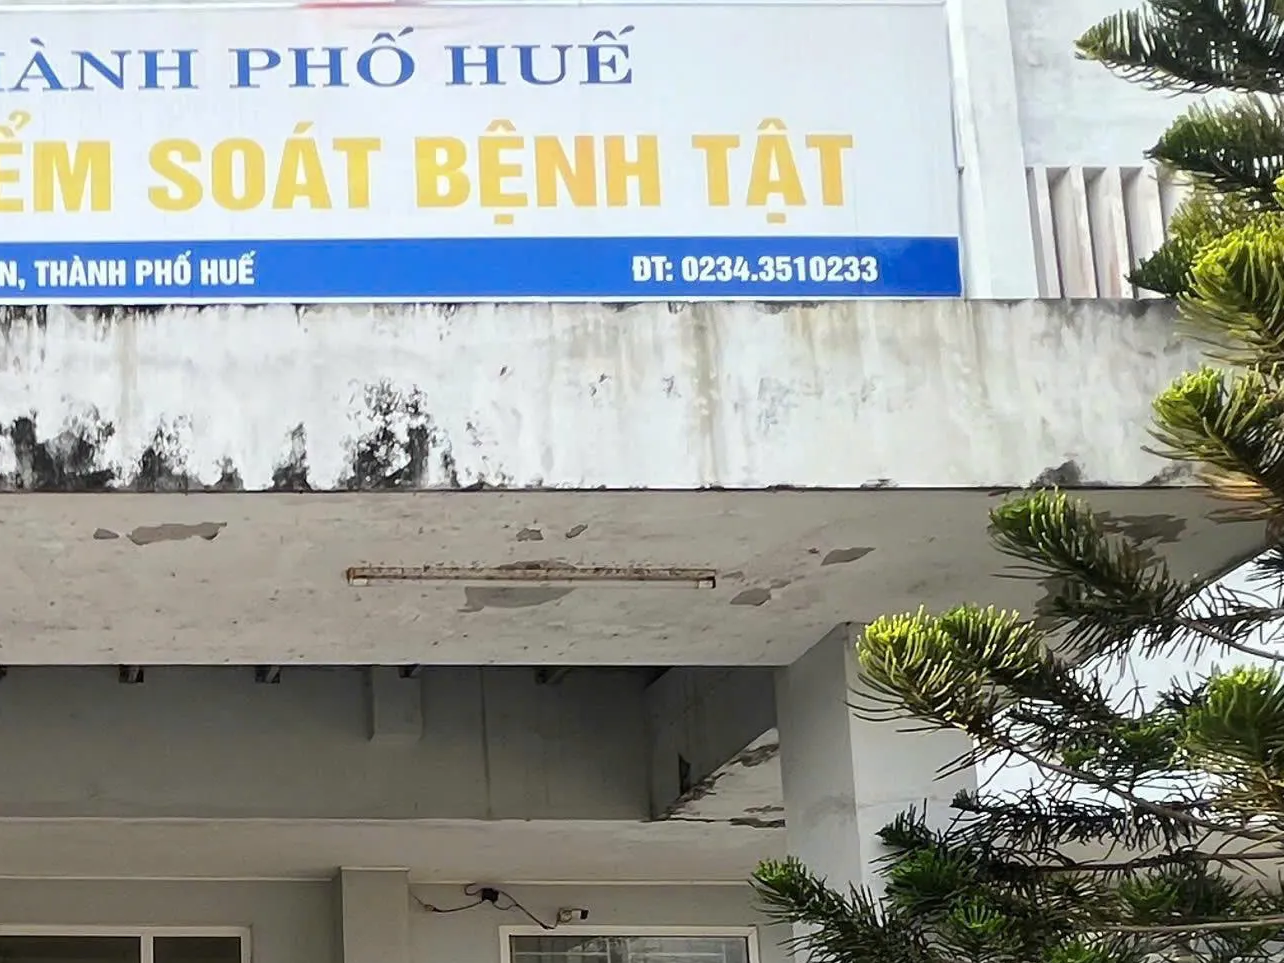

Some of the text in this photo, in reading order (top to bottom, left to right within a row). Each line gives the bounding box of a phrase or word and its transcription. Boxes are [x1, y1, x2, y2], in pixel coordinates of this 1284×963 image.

[229, 26, 415, 89] PHỐ
[445, 25, 635, 86] HUẾ
[148, 121, 382, 212] SOÁT
[415, 119, 662, 225] BỆNH
[692, 117, 854, 225] TẬT
[34, 255, 126, 287] THÀNH
[135, 250, 192, 286] PHỐ
[200, 250, 257, 285] HUẾ
[632, 255, 879, 282] ĐT: 0234.3510233
